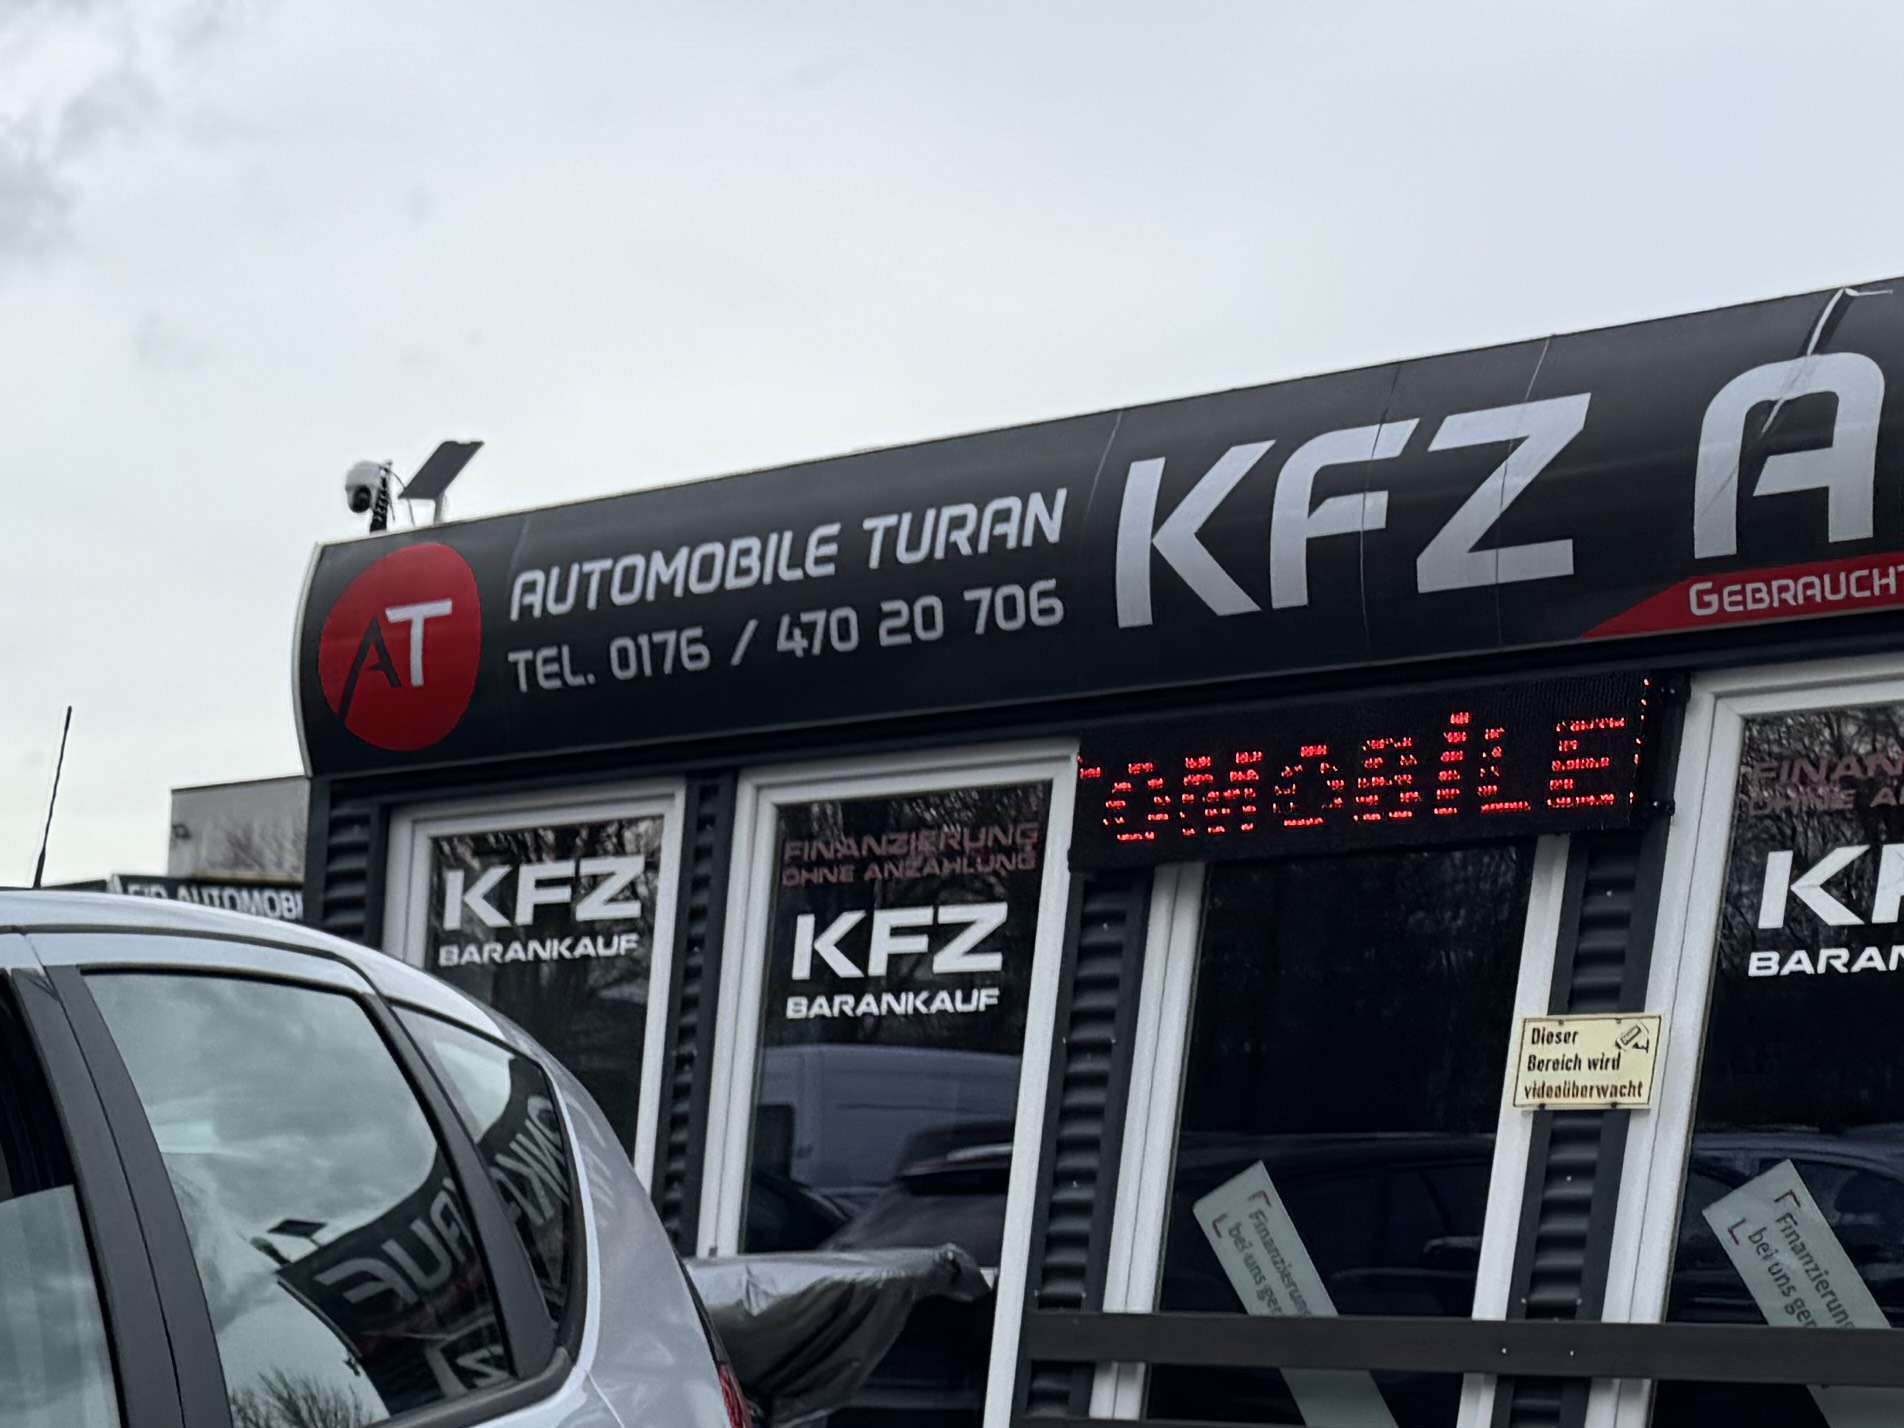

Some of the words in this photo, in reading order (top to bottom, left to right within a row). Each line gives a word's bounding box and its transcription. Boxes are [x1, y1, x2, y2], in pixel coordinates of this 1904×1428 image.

[1116, 391, 1592, 629] KFZ
[509, 522, 842, 622] AUTOMOBILE
[862, 487, 1068, 570] TURAN
[1689, 564, 1904, 617] GEBRAUCH
[508, 645, 595, 694] TEL.
[609, 626, 711, 681] 0176
[730, 619, 759, 667] /
[776, 606, 860, 659] 470
[879, 595, 945, 647] 20
[963, 577, 1065, 635] 706
[338, 598, 454, 722] AT
[783, 821, 1041, 864] FINANZIERUNG
[443, 854, 646, 932] KFZ
[781, 864, 854, 888] OHNE
[864, 850, 1037, 881] ANZAHLUNG
[439, 932, 640, 967] BARANKAUF
[792, 902, 1009, 981] KFZ
[786, 987, 1000, 1020] BARANKAUF
[1531, 1026, 1580, 1046] Dieser
[1527, 1052, 1583, 1072] Bereich
[1586, 1051, 1622, 1072] wird
[1524, 1079, 1644, 1100] videoüberwacht
[1228, 1222, 1254, 1253] bei
[1747, 1226, 1779, 1261] bei
[1767, 1261, 1797, 1298] uns
